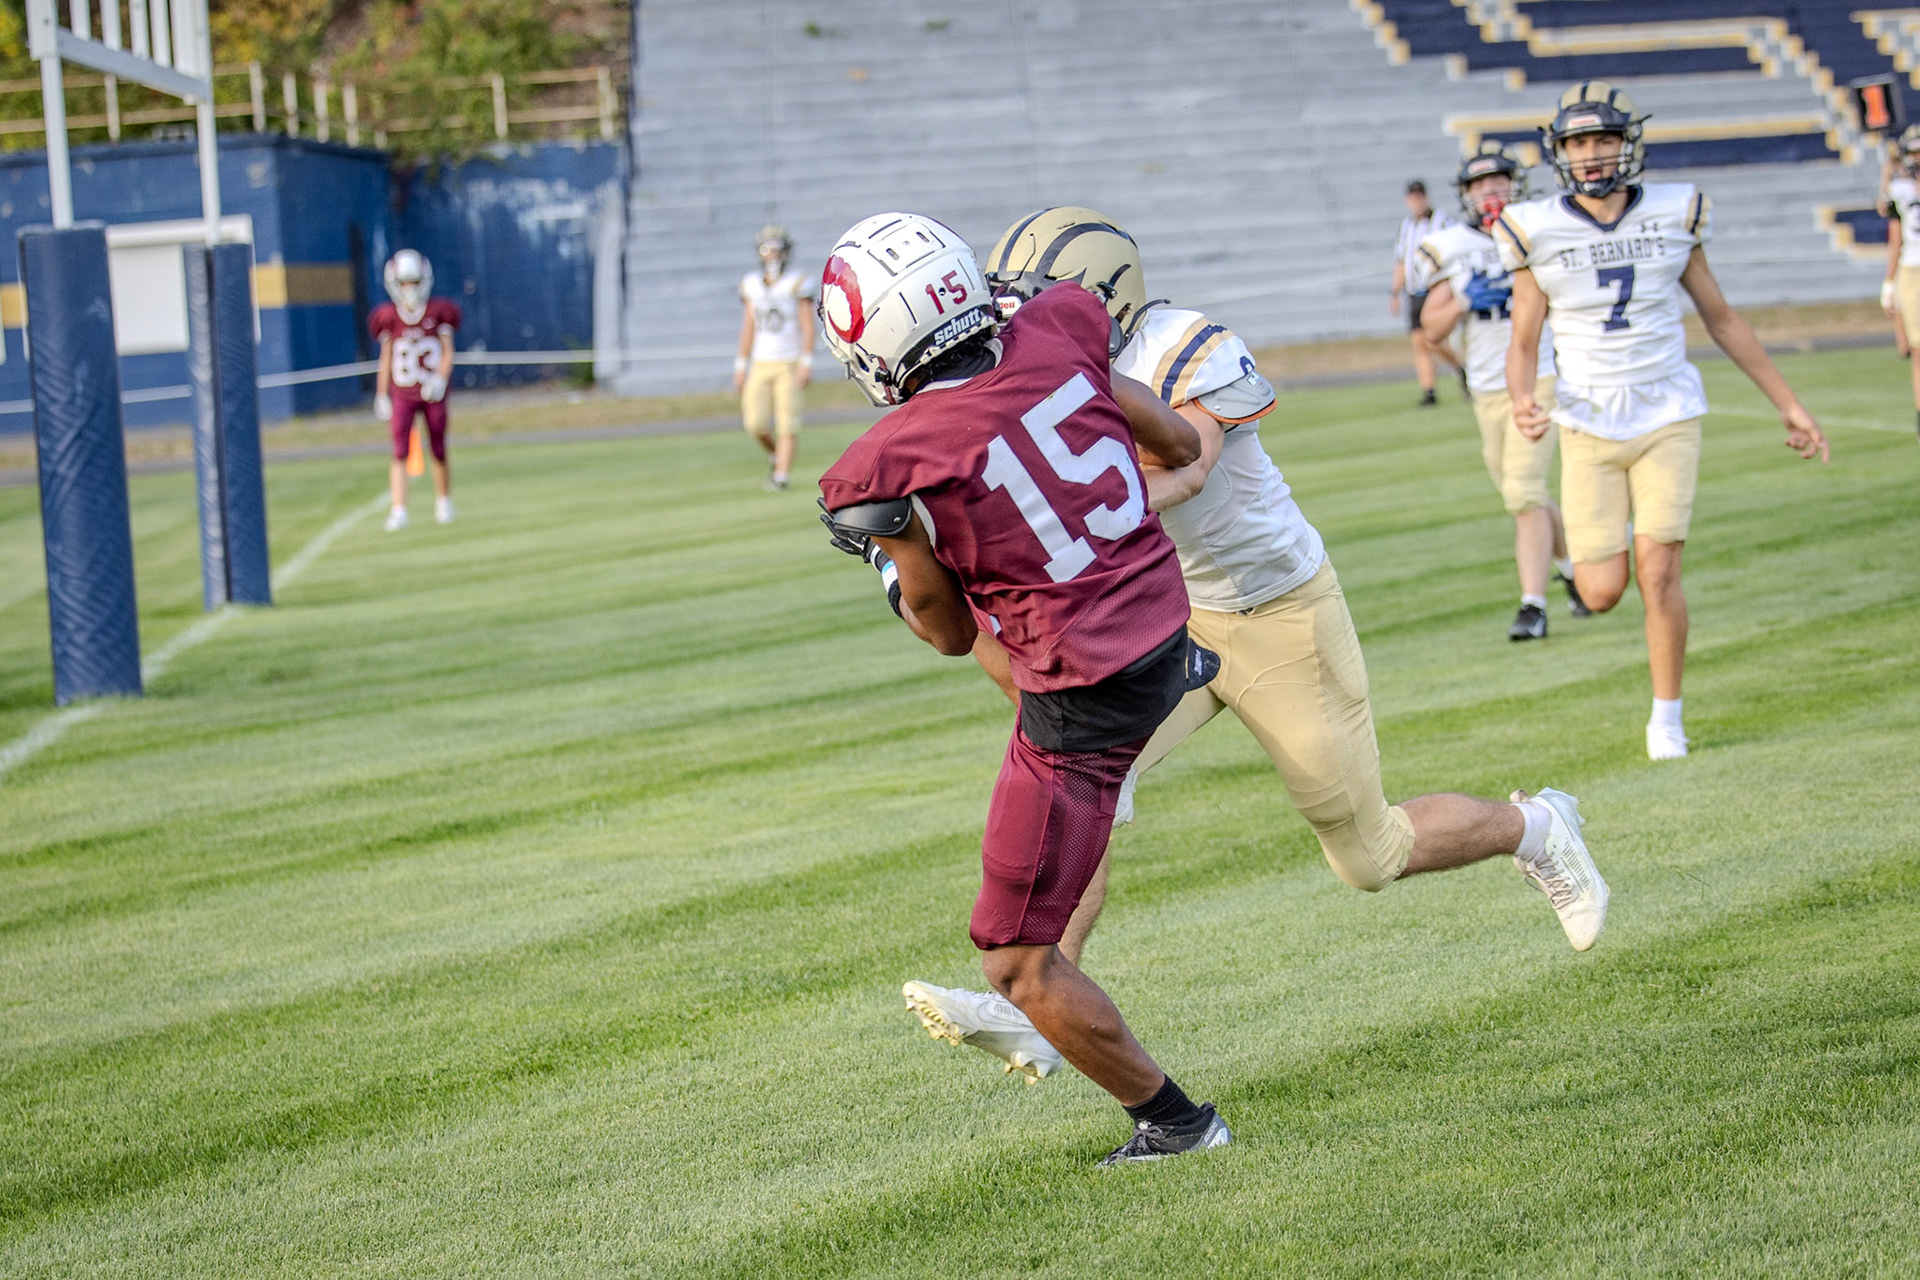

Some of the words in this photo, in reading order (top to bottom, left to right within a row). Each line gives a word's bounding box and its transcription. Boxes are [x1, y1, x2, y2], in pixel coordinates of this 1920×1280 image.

[1862, 85, 1889, 127] 1
[1560, 248, 1582, 269] ST.
[1589, 237, 1665, 265] BERNARD'S
[924, 270, 967, 315] 15
[1597, 265, 1634, 331] 7
[981, 371, 1146, 584] 15
